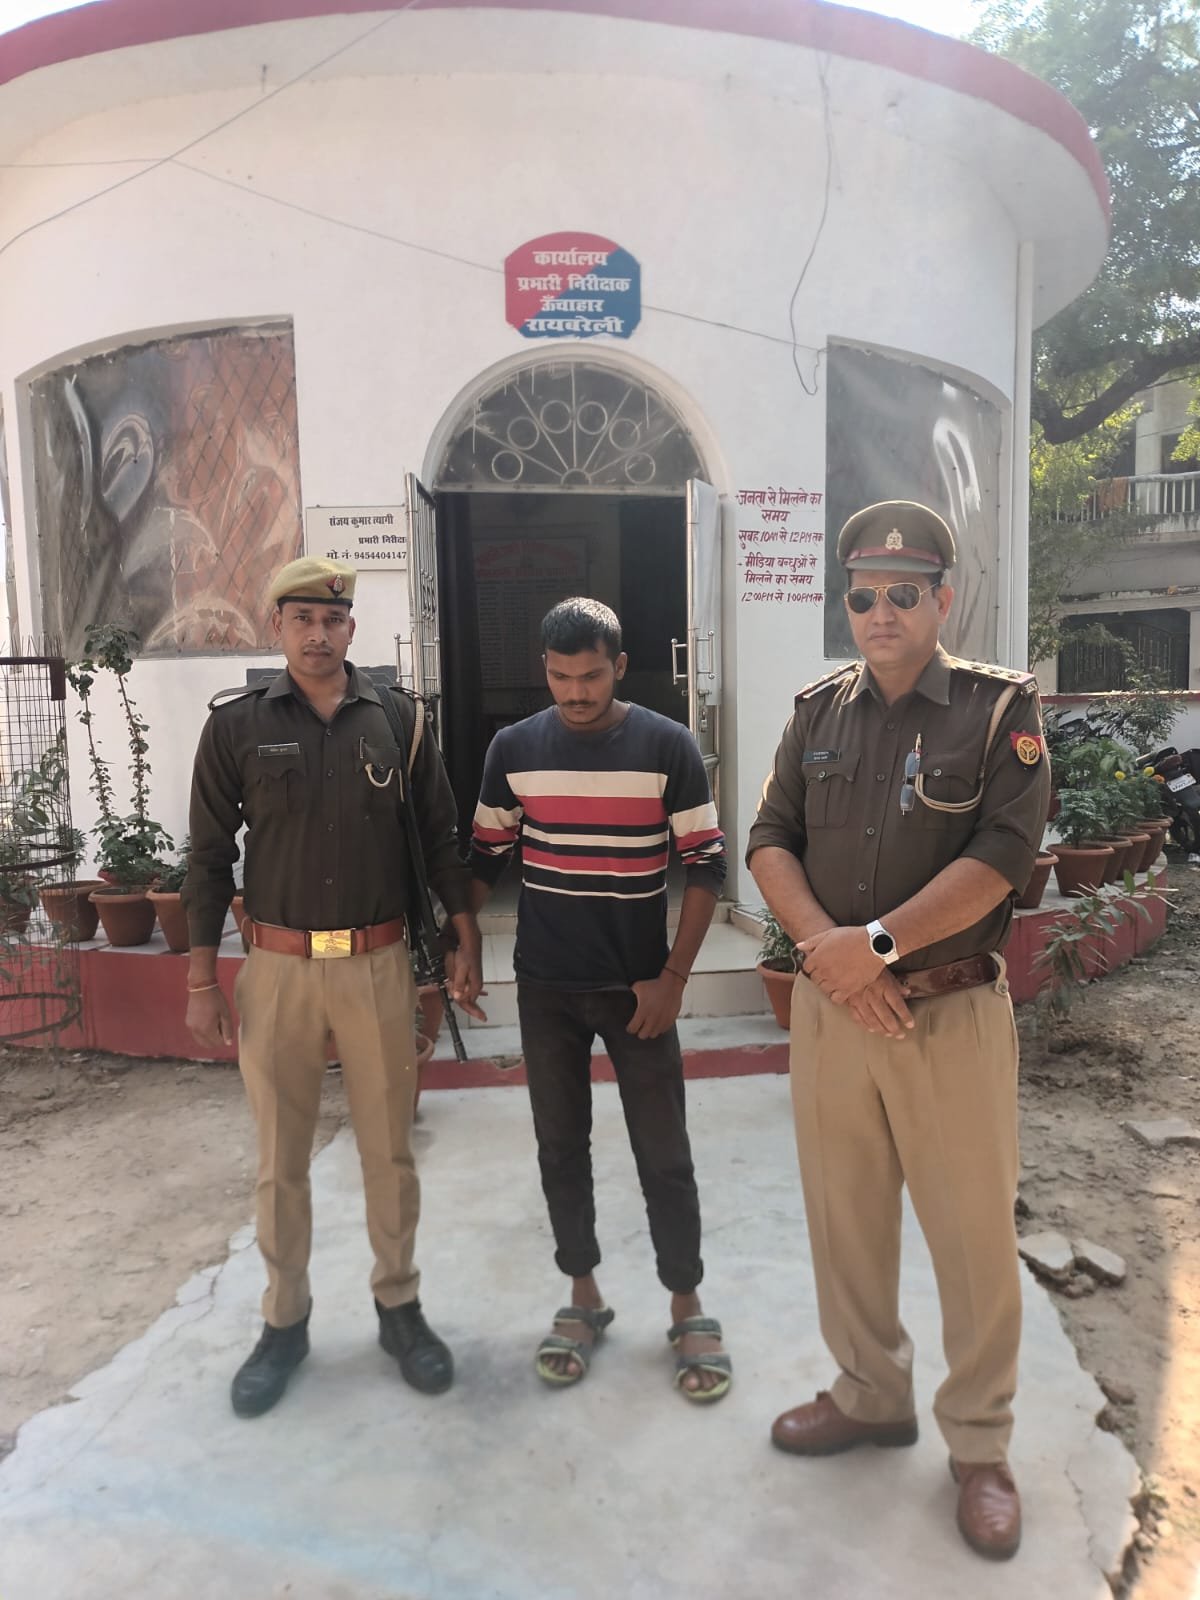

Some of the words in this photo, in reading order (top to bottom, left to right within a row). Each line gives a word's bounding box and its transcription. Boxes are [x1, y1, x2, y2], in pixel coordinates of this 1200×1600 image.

[532, 247, 608, 266] कार्यालय
[516, 274, 562, 291] प्रभारी
[567, 274, 632, 292] निरीक्षक
[524, 315, 624, 332] रायबरेली
[738, 489, 766, 508] जनता
[767, 486, 776, 506] से
[778, 486, 808, 507] मिलने
[809, 492, 823, 504] का
[329, 515, 349, 526] संजय
[351, 516, 371, 528] कुमार
[372, 513, 394, 525] त्यागी
[761, 509, 790, 523] समय
[382, 535, 407, 544] निरीक्ष
[738, 530, 760, 550] सुबह
[779, 526, 788, 544] से
[354, 551, 407, 560] 9454404147
[745, 551, 775, 568] मीडिया
[808, 553, 818, 570] से
[744, 569, 773, 586] मिलने
[774, 574, 788, 585] का
[789, 574, 814, 586] समय
[774, 588, 785, 603] से
